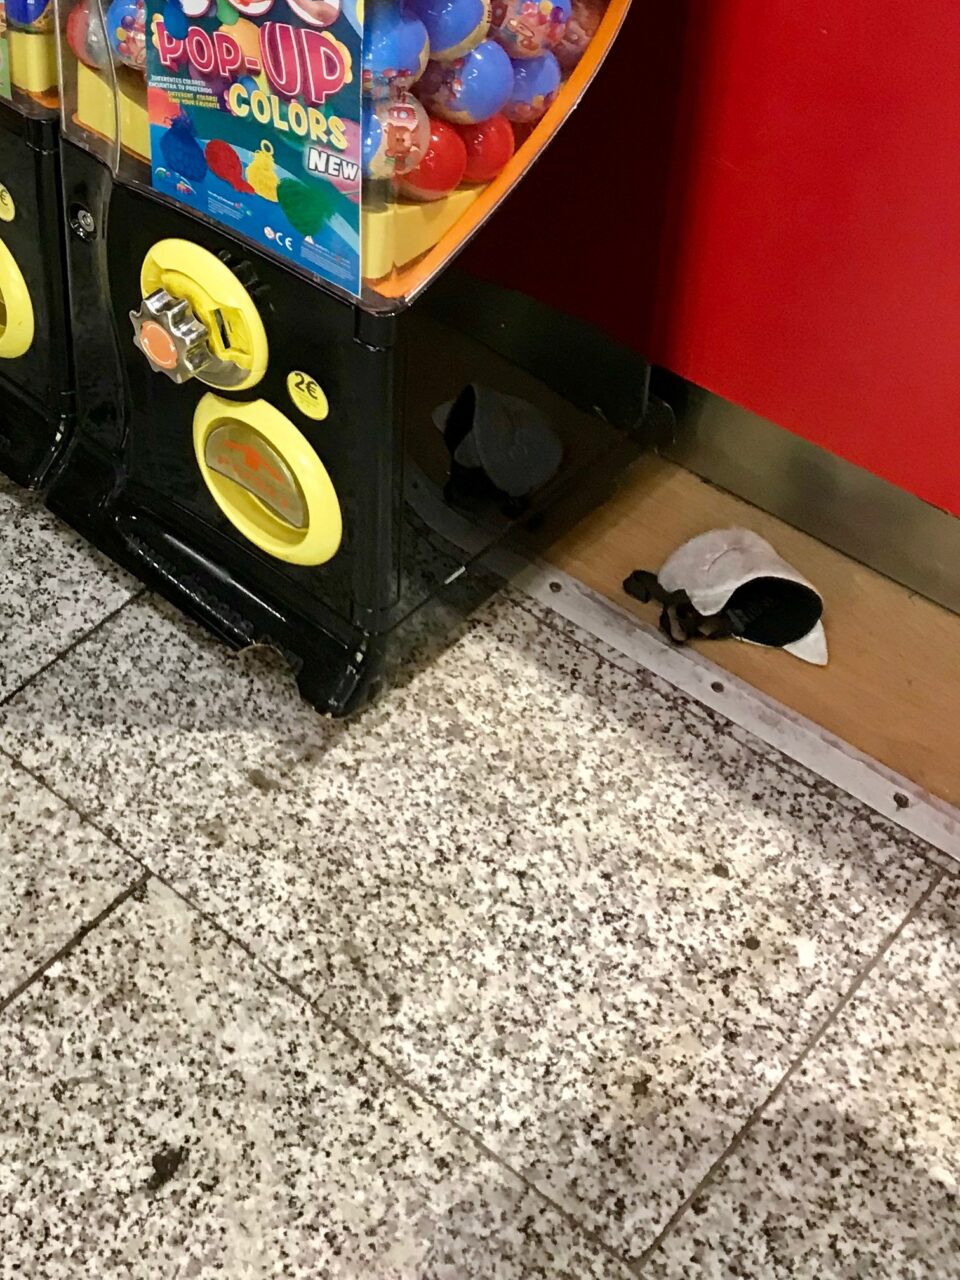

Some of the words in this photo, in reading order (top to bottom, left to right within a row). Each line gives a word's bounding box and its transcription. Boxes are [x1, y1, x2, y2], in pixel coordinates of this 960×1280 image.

[155, 21, 346, 104] POP-UP
[228, 82, 349, 150] COLORS
[307, 146, 360, 182] NEW
[294, 372, 318, 401] 2€
